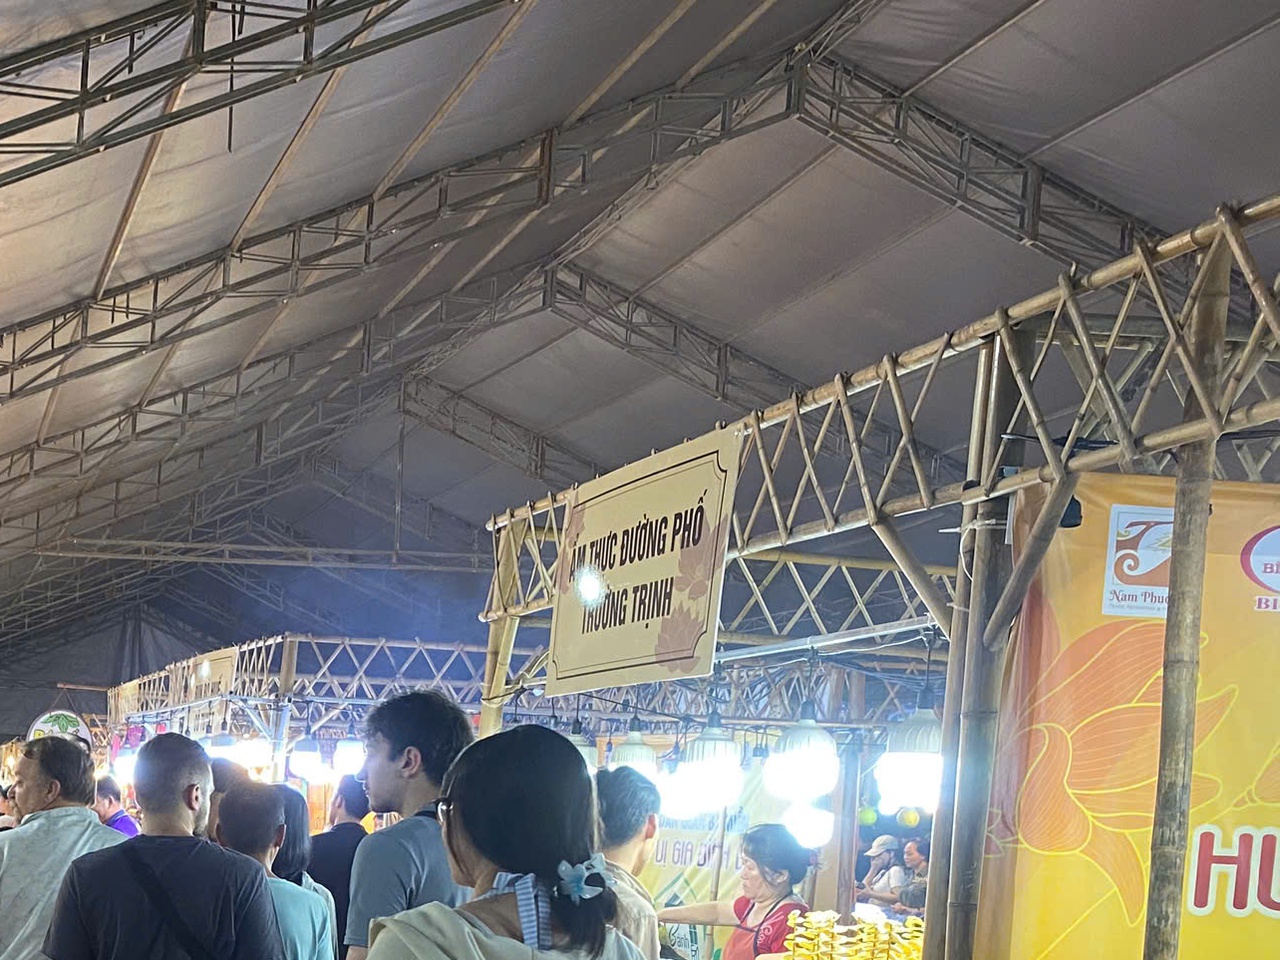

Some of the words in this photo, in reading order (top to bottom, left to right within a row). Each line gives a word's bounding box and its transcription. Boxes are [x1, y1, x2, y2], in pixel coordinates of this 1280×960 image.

[619, 514, 668, 568] ĐƯỜNG
[670, 489, 708, 552] PHỐ
[631, 576, 674, 629] TRỊNH
[1109, 589, 1138, 603] Nam
